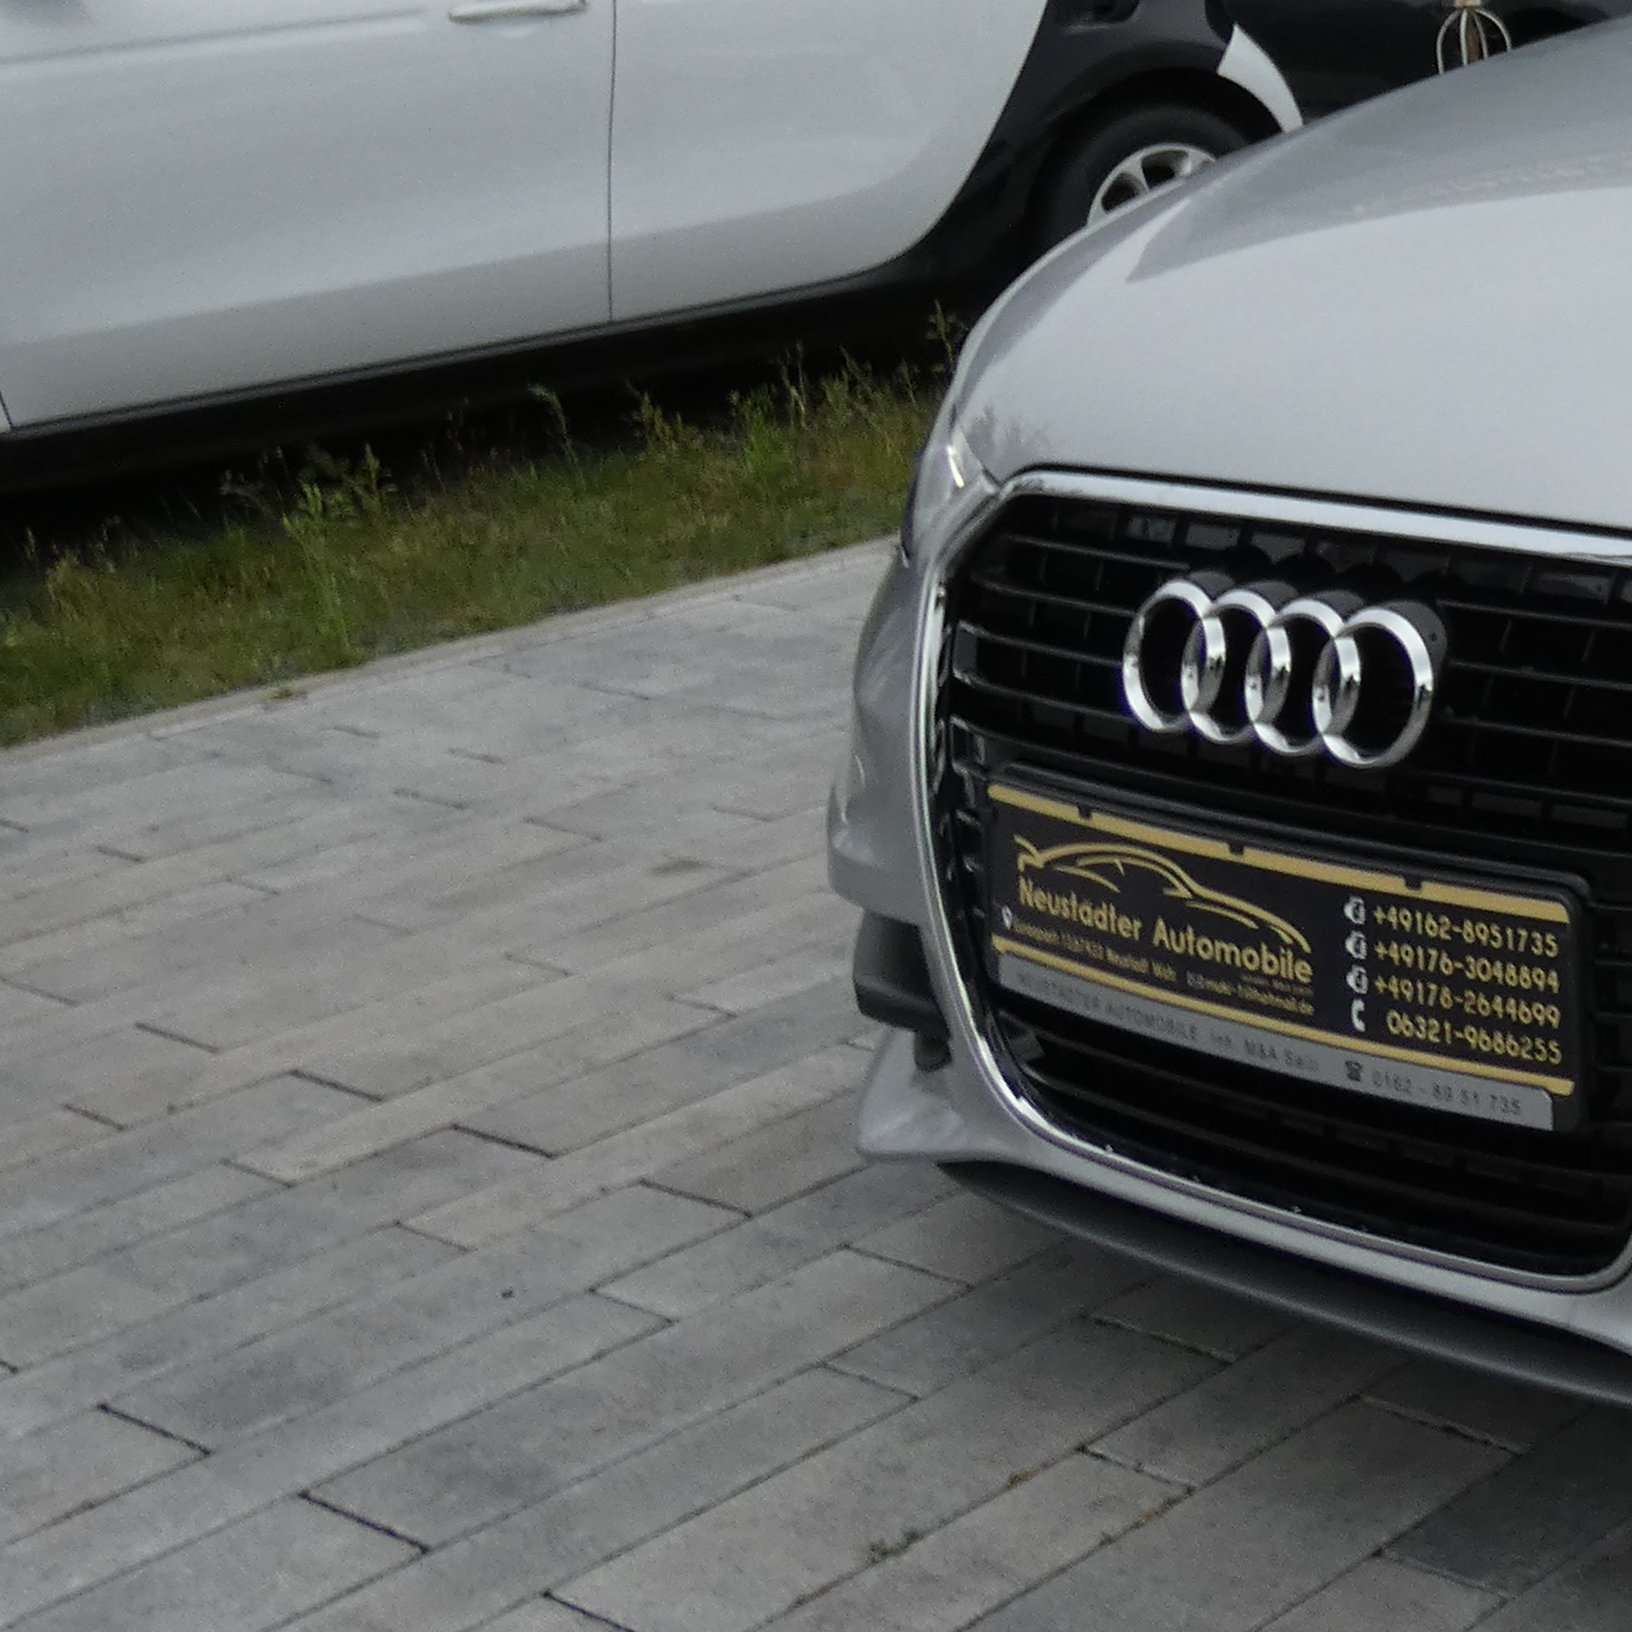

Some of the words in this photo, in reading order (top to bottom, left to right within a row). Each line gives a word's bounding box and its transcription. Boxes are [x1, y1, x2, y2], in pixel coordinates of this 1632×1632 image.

[1153, 917, 1313, 984] Automobile
[1373, 904, 1559, 958] +49162-8951735
[1374, 940, 1560, 994] +49176-3048894
